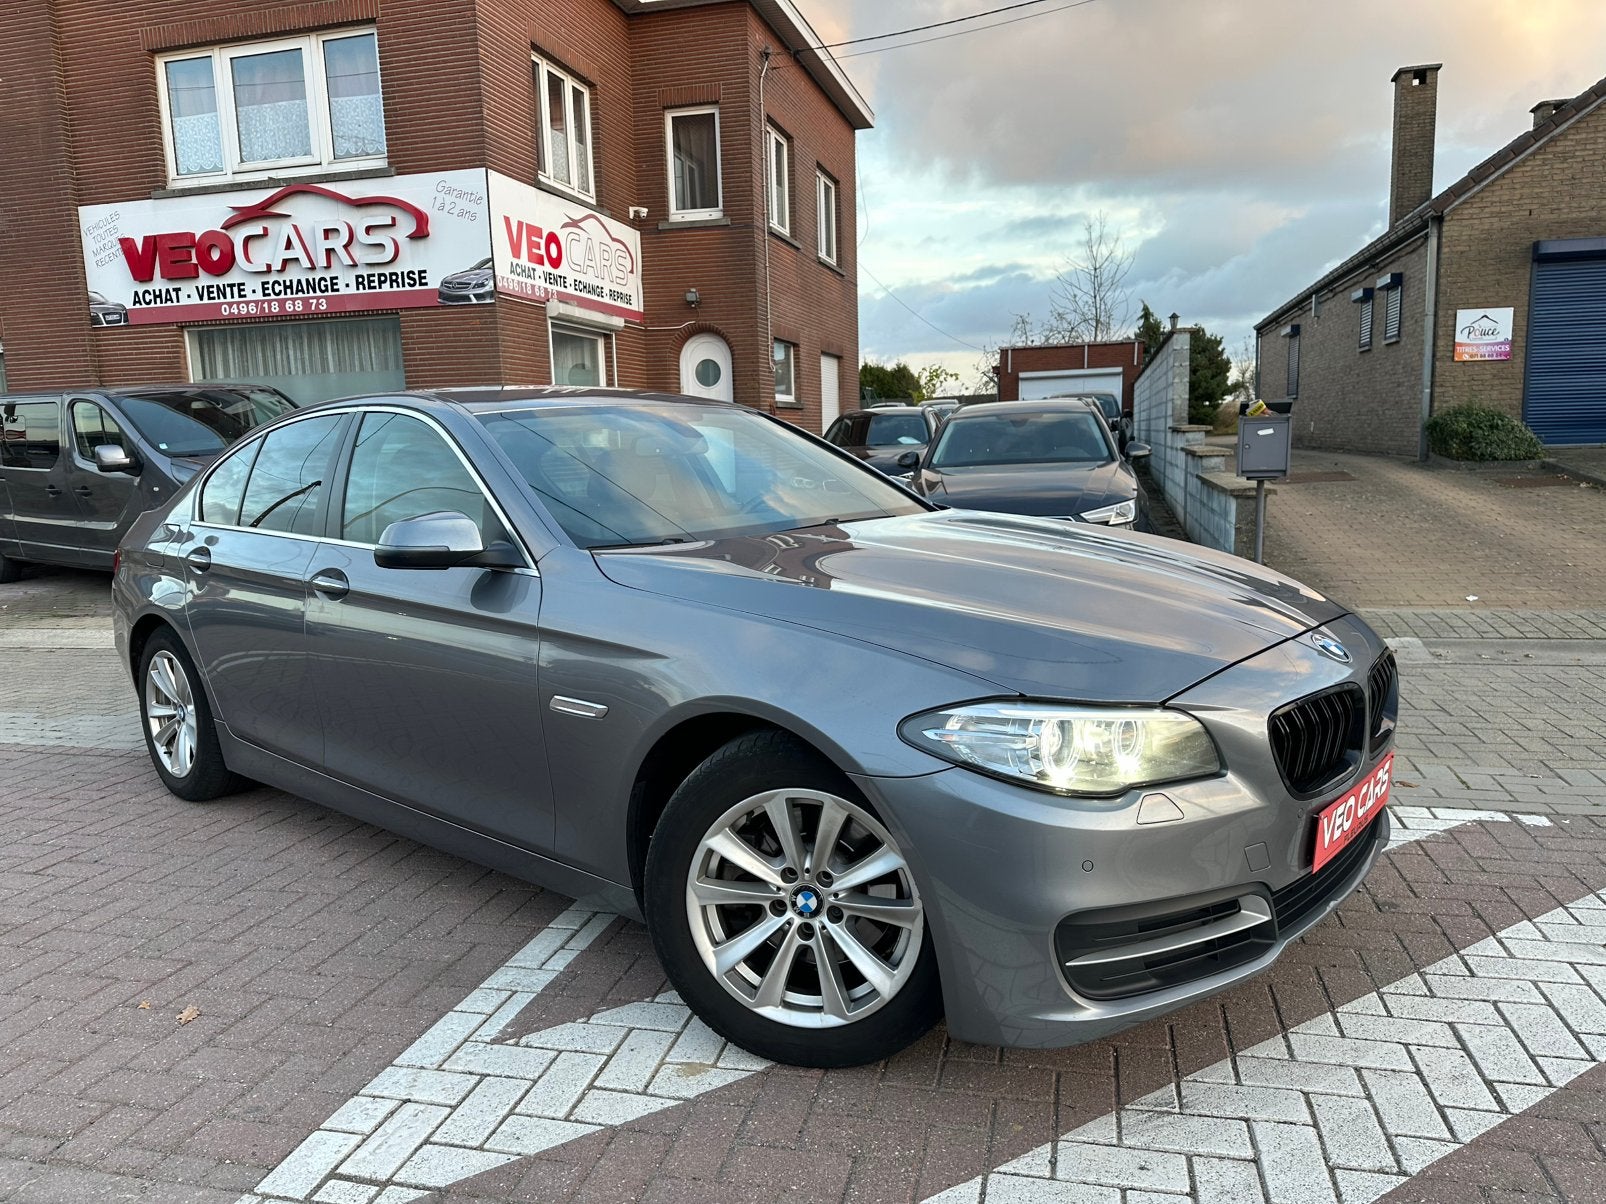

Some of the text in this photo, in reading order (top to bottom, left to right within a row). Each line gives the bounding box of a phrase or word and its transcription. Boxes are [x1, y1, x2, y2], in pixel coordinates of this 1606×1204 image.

[436, 180, 483, 206] Garantie
[432, 196, 437, 209] 1
[447, 202, 457, 215] 2
[457, 208, 478, 222] ans
[83, 211, 121, 237] VEHICULES
[92, 225, 119, 244] TOUTES
[132, 270, 428, 306] ACHAT VENTE ECHANGE REPRISE
[510, 261, 632, 306] ACHAT VENTE ECHANGE REPRISE
[534, 285, 545, 298] 68
[221, 299, 327, 316] 0496/18 68 73
[1460, 325, 1500, 339] Pouce
[1323, 795, 1356, 849] VEO
[1357, 759, 1391, 818] CARS
